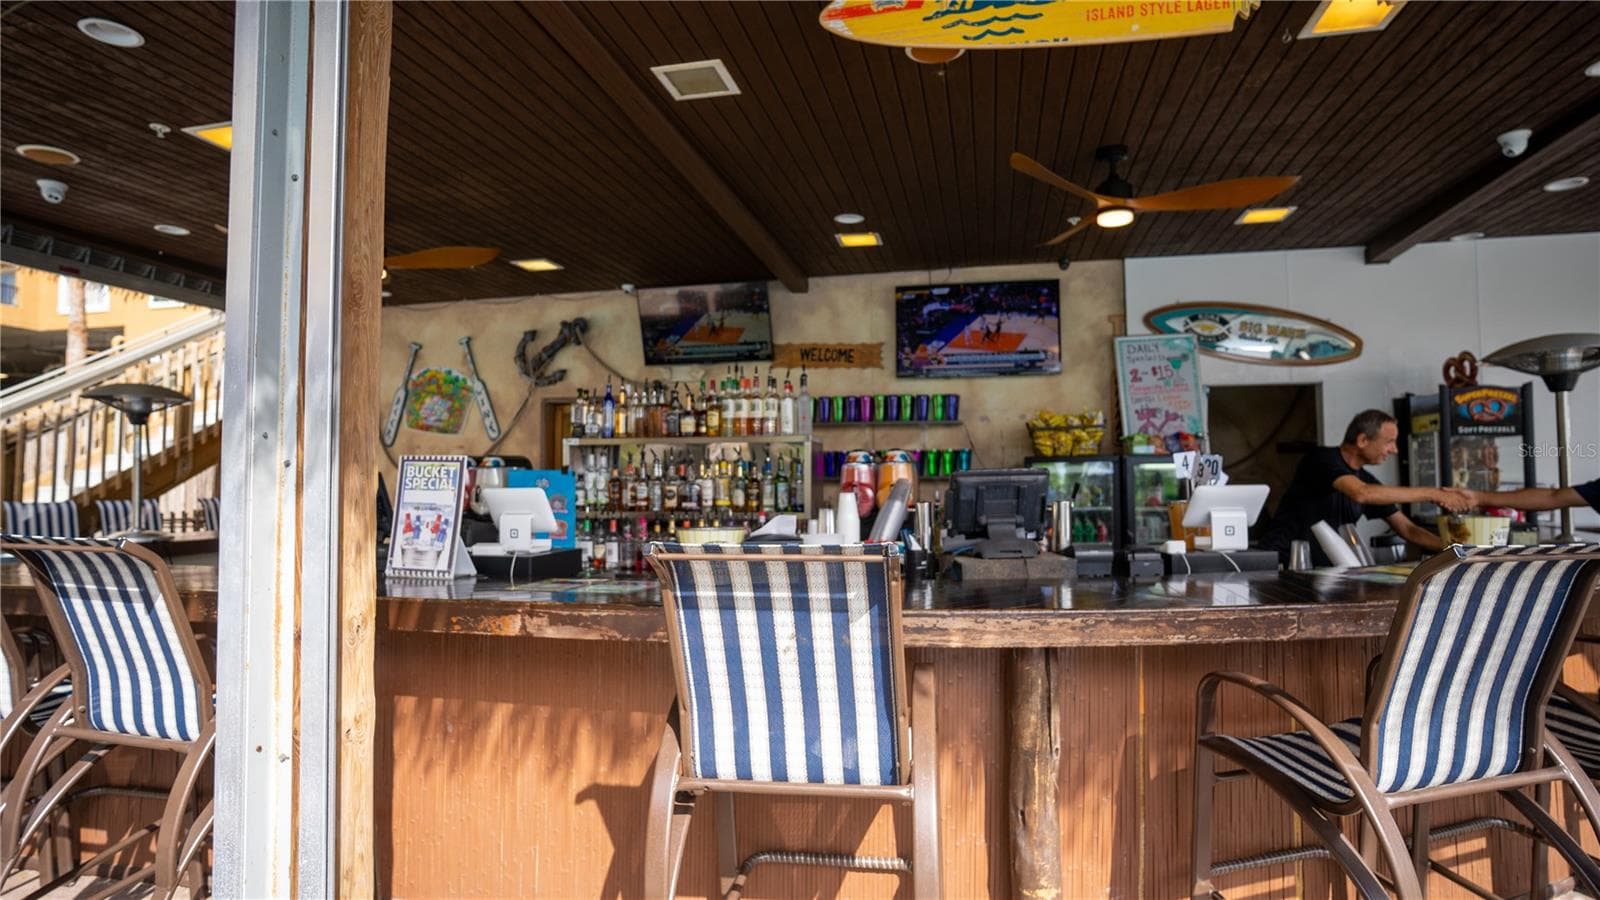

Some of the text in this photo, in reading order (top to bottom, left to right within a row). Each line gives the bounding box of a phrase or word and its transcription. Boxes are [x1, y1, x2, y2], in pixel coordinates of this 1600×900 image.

[1086, 0, 1231, 22] ISLAND STYLE LAGER
[799, 347, 856, 363] WELCOME
[1126, 341, 1160, 355] DAILY
[1182, 455, 1190, 471] 4
[406, 465, 457, 478] BUCKET
[404, 477, 456, 490] SPECIAL
